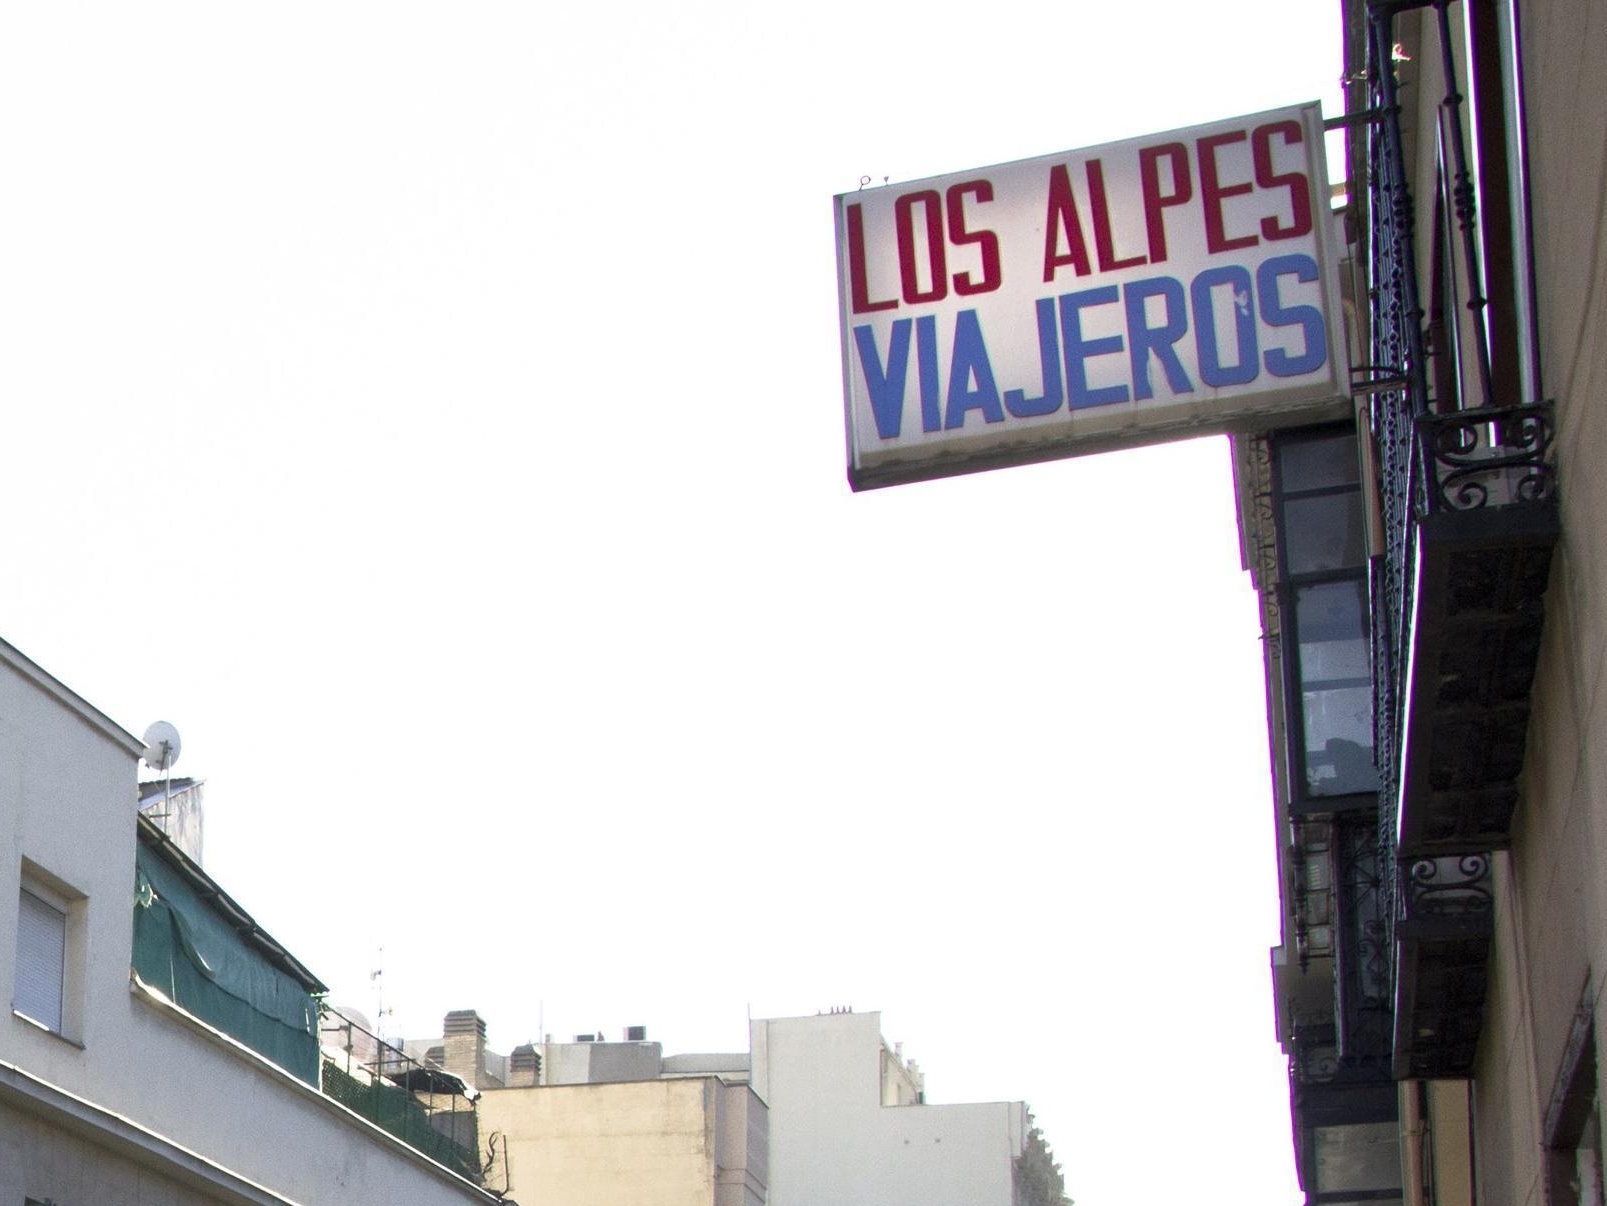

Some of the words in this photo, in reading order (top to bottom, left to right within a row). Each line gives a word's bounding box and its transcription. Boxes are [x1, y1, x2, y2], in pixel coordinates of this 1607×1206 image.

[847, 179, 1001, 314] LOS
[1043, 120, 1313, 282] ALPES
[854, 254, 1327, 440] VIAJEROS
